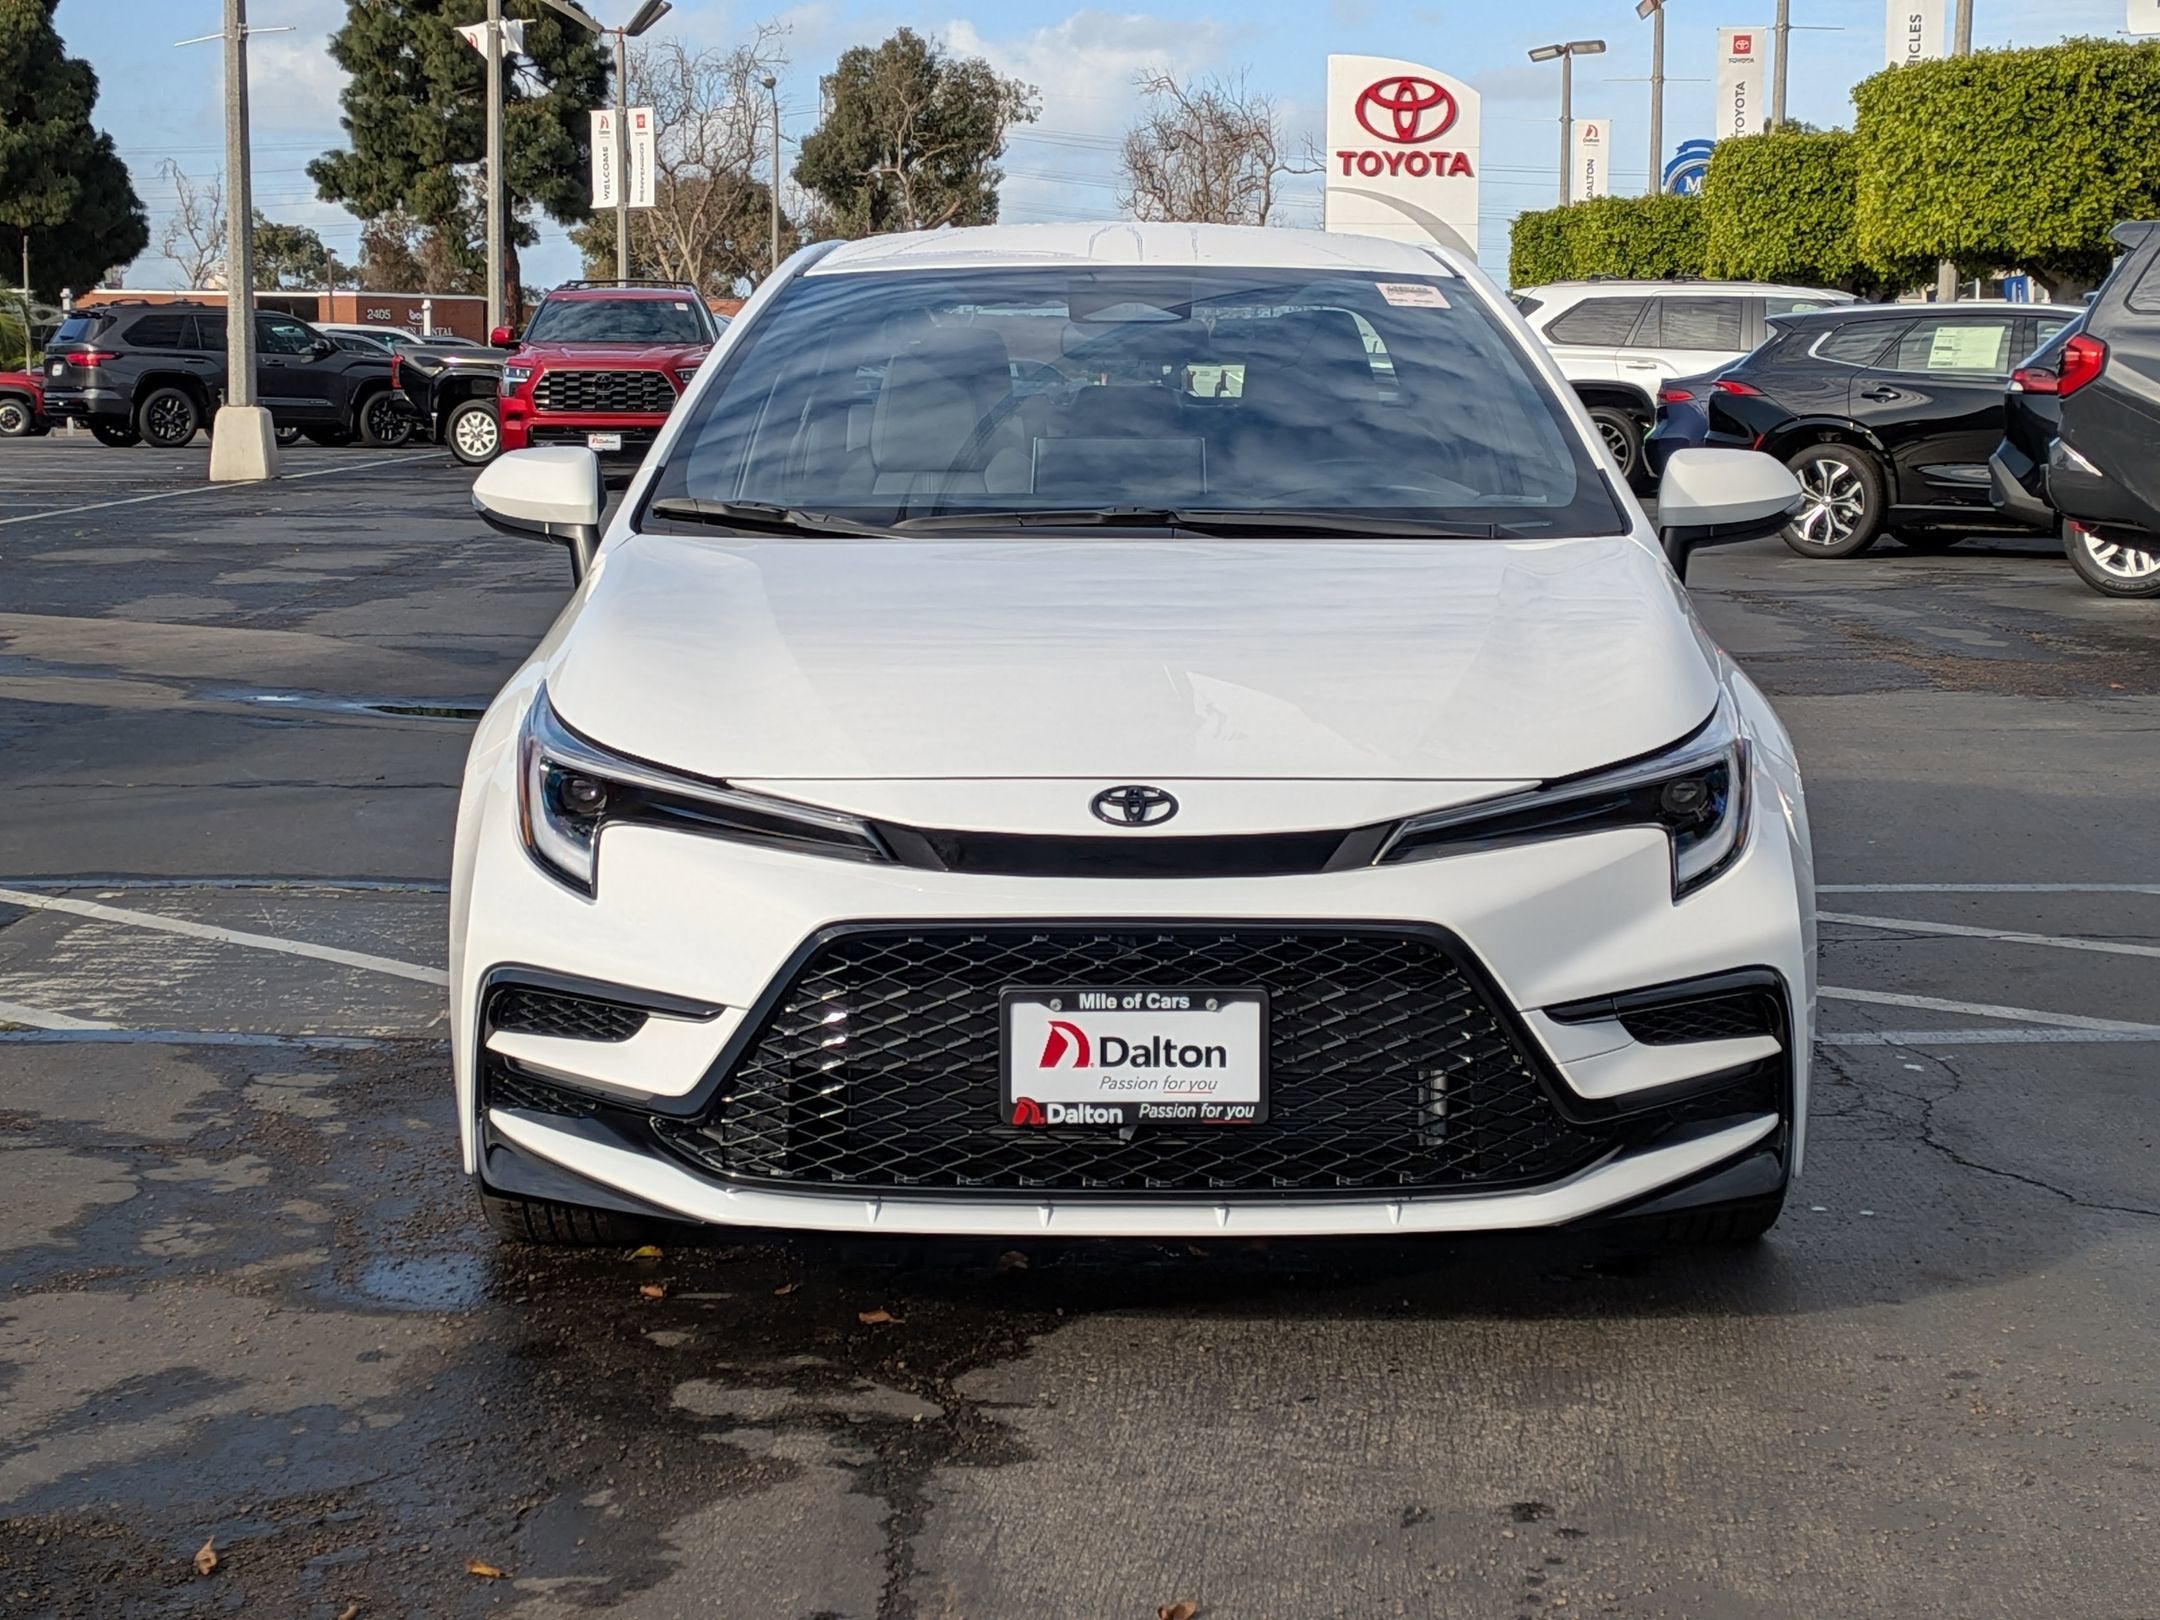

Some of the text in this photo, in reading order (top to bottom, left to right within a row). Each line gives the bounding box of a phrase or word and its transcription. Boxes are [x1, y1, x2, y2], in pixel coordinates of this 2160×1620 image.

[1734, 81, 1746, 137] TOYOTA
[602, 146, 611, 200] WELCOME
[1336, 150, 1476, 178] TOYOTA
[1586, 158, 1595, 198] DALTON
[366, 308, 392, 320] 2405
[1078, 993, 1190, 1009] Mile of Cars
[1099, 1035, 1227, 1068] Dalton
[1098, 1075, 1218, 1092] Passion for you
[1047, 1102, 1255, 1124] Dalton Passion for you
